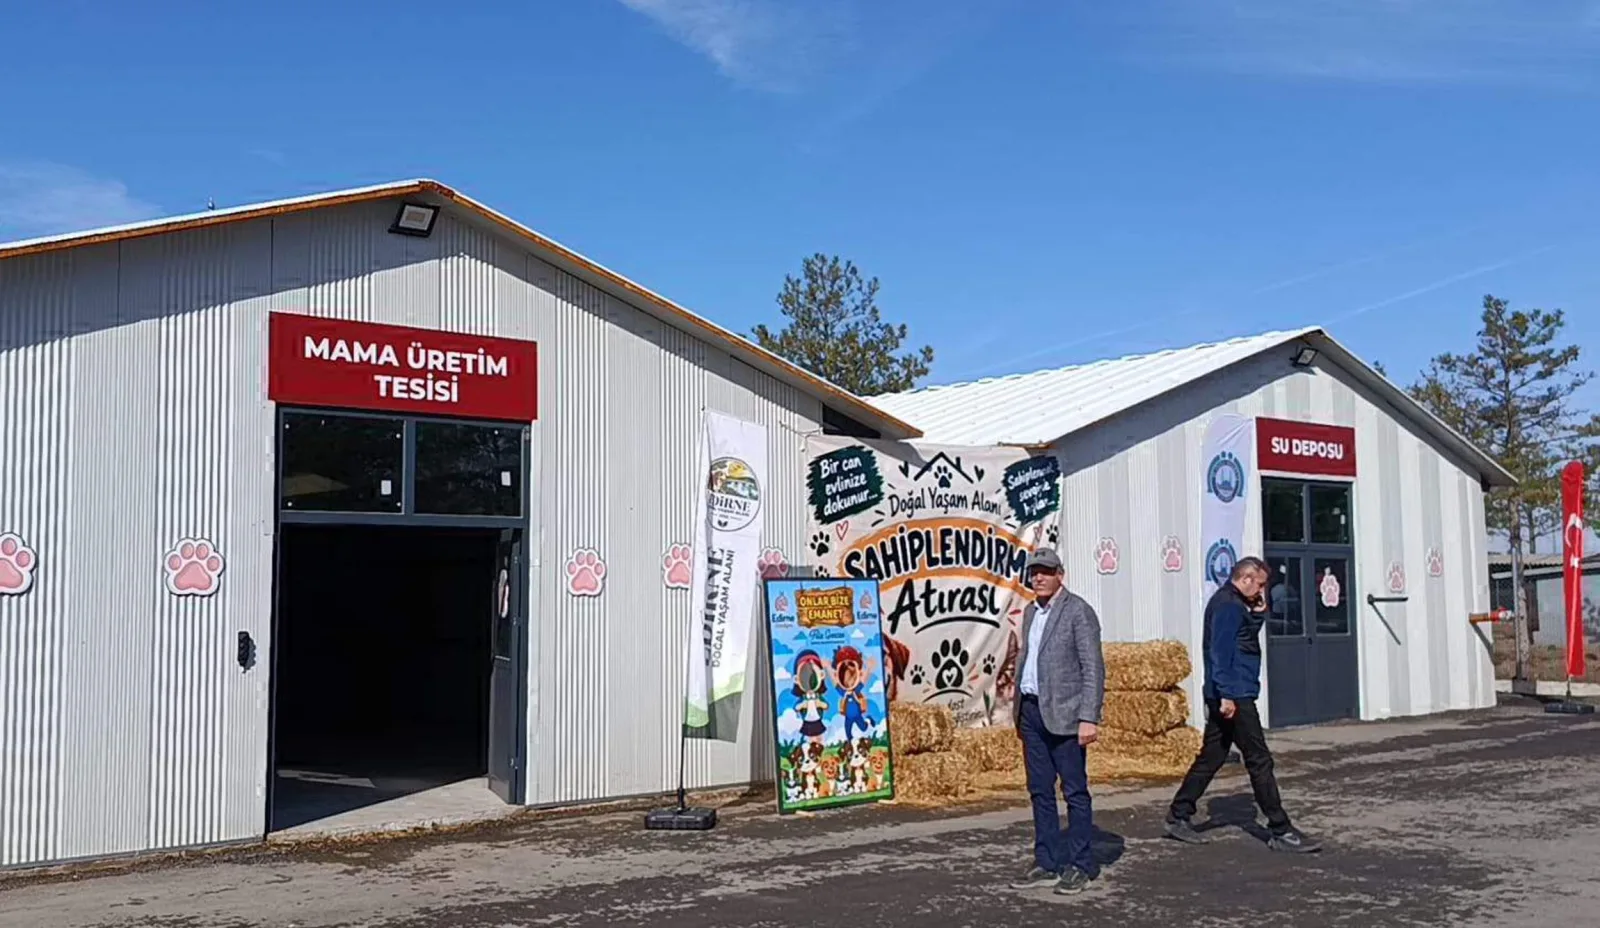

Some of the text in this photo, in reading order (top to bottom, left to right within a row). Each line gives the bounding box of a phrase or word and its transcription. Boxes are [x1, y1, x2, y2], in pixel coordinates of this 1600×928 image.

[304, 335, 508, 377] MAMA ÜRETİM
[374, 373, 458, 402] TESİSİ
[1271, 436, 1344, 460] SU DEPOSU
[820, 457, 862, 479] Bir can
[888, 488, 926, 518] Doğal
[928, 486, 968, 514] Yaşam
[971, 490, 1001, 515] Alanı
[711, 549, 735, 668] DOĞAL YAŞAM ALANI
[800, 593, 850, 607] ONLAR BİZE
[808, 609, 843, 620] EMANET
[887, 578, 1000, 635] Atırası
